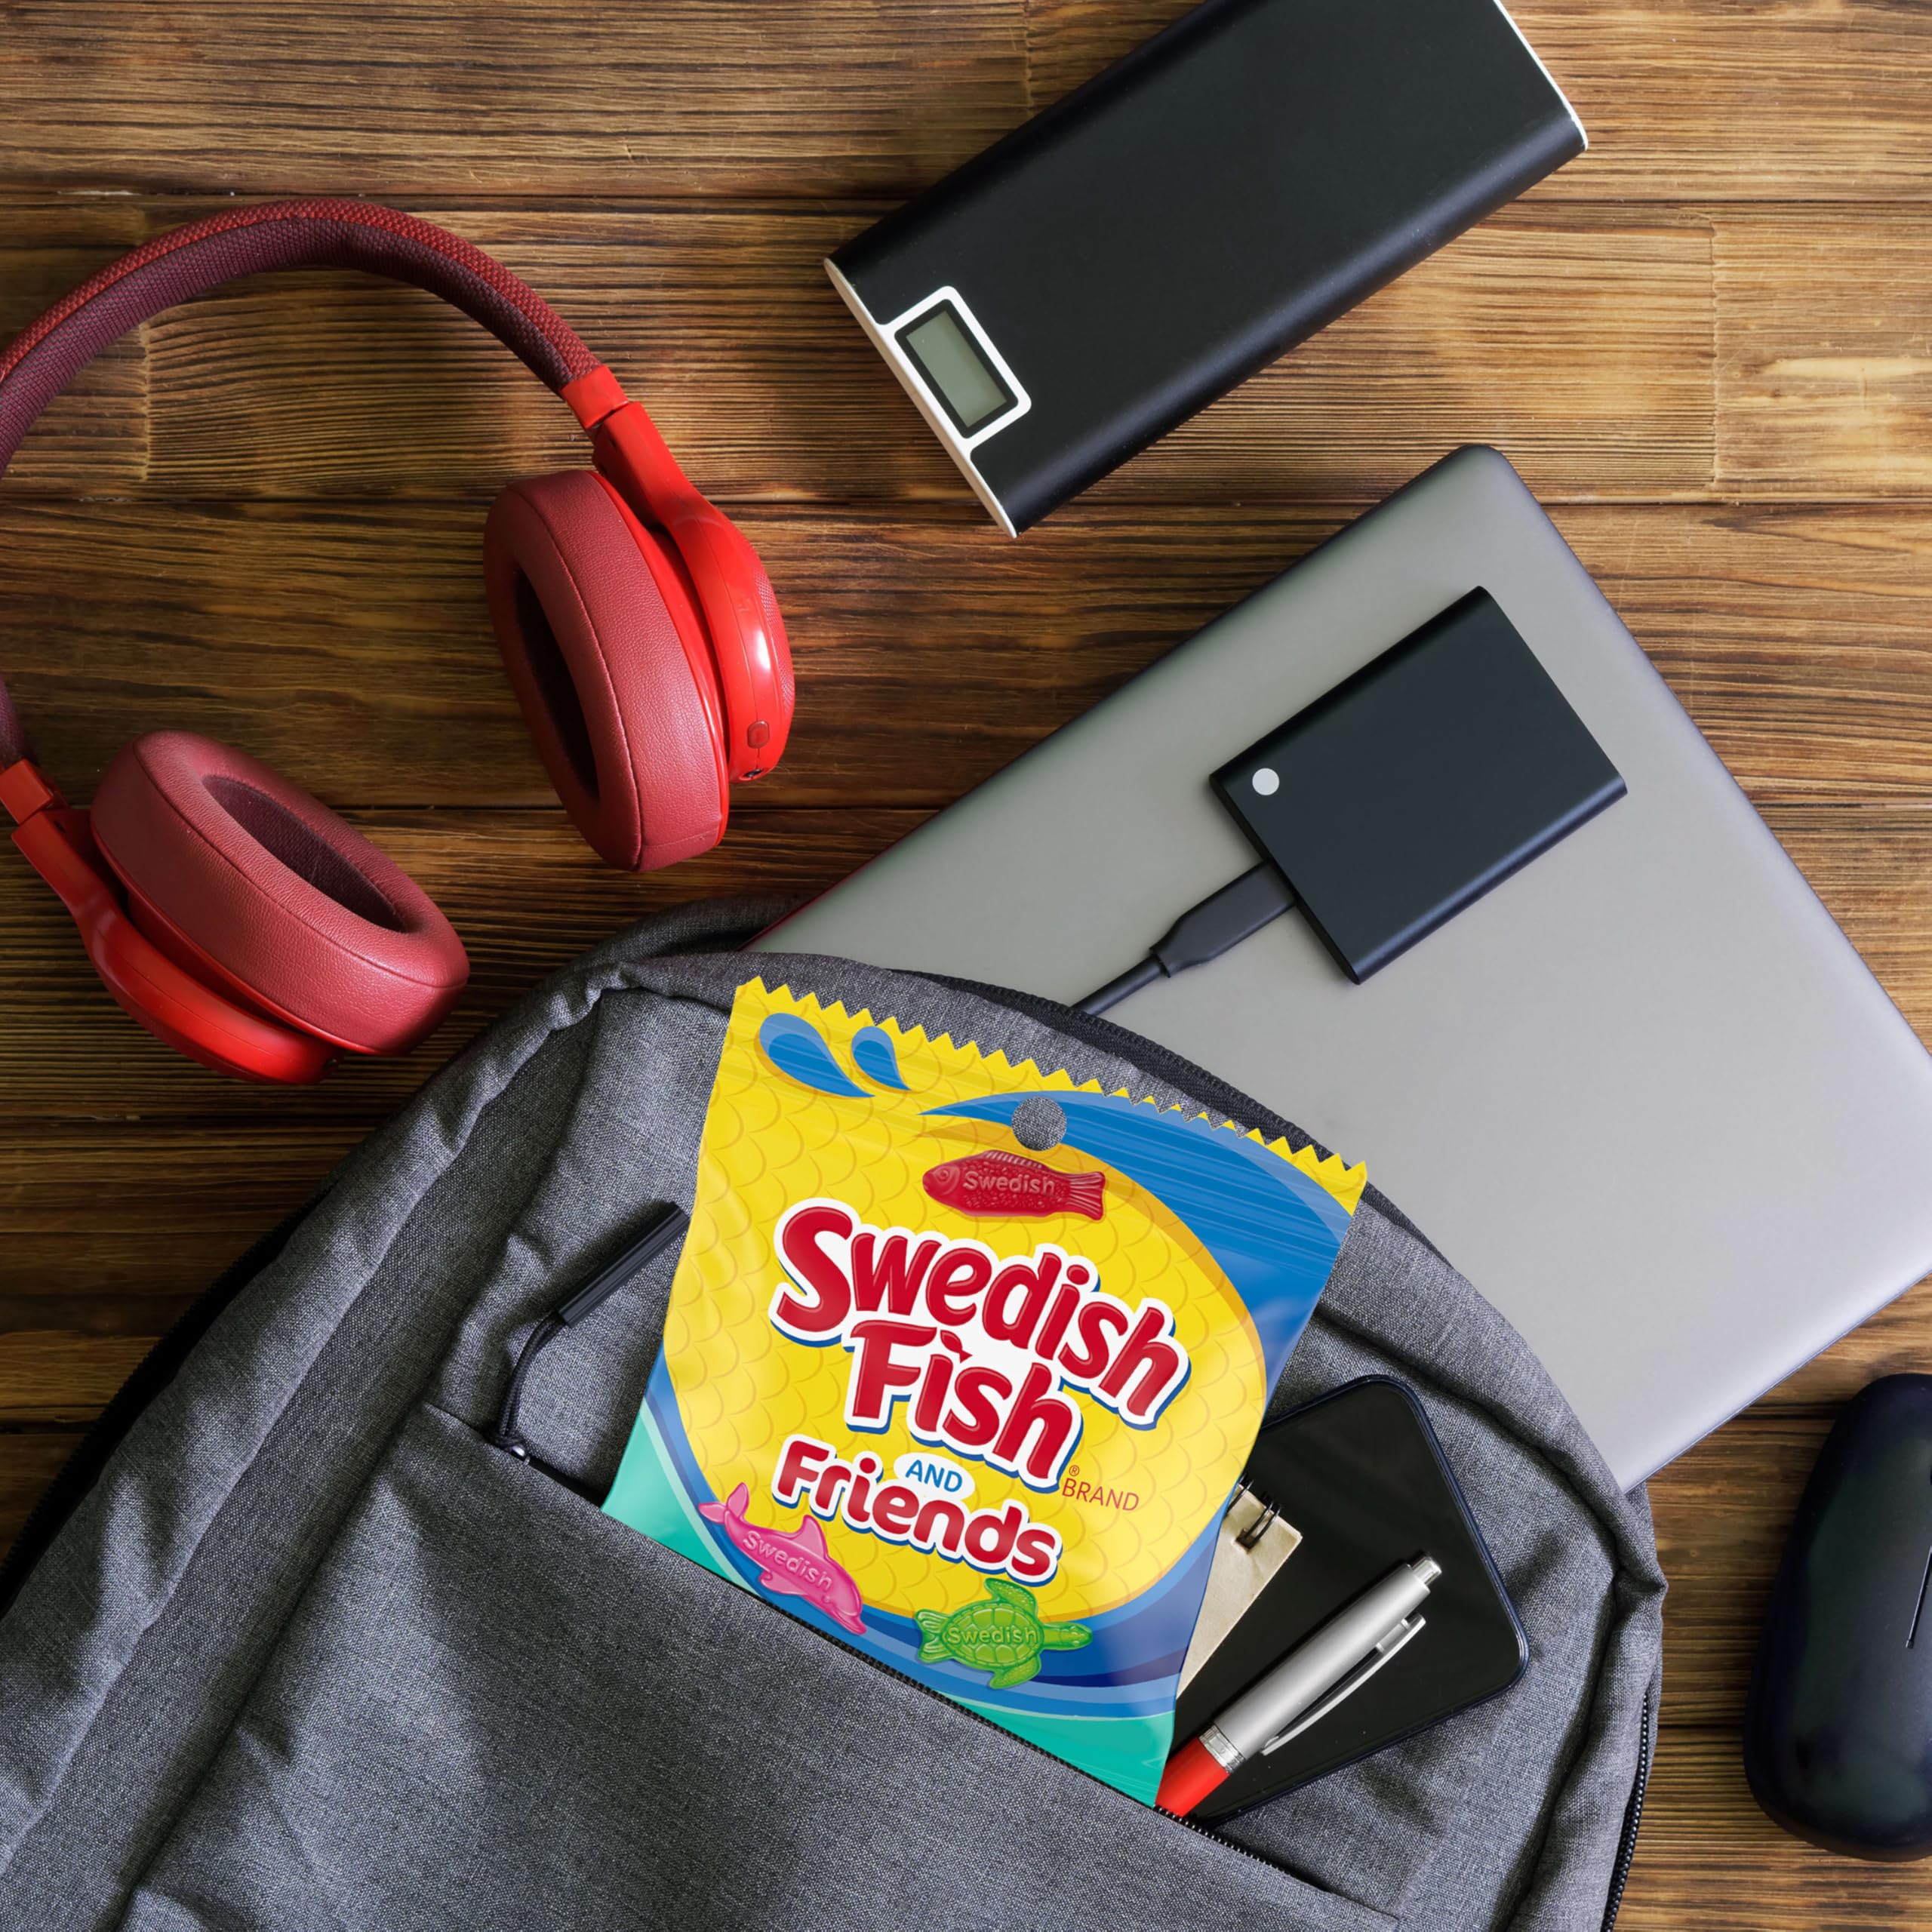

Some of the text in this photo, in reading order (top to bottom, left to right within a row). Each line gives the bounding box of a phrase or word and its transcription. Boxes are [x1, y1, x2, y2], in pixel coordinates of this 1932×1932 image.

[963, 1171, 1056, 1195] Swedish
[775, 1204, 1180, 1418] Swedish
[849, 1318, 1075, 1480] Fish
[905, 1459, 963, 1493] AND
[1062, 1477, 1140, 1511] BRAND
[776, 1439, 1058, 1577] Friends
[742, 1530, 832, 1592] Swedish
[947, 1625, 1038, 1644] Swedish
